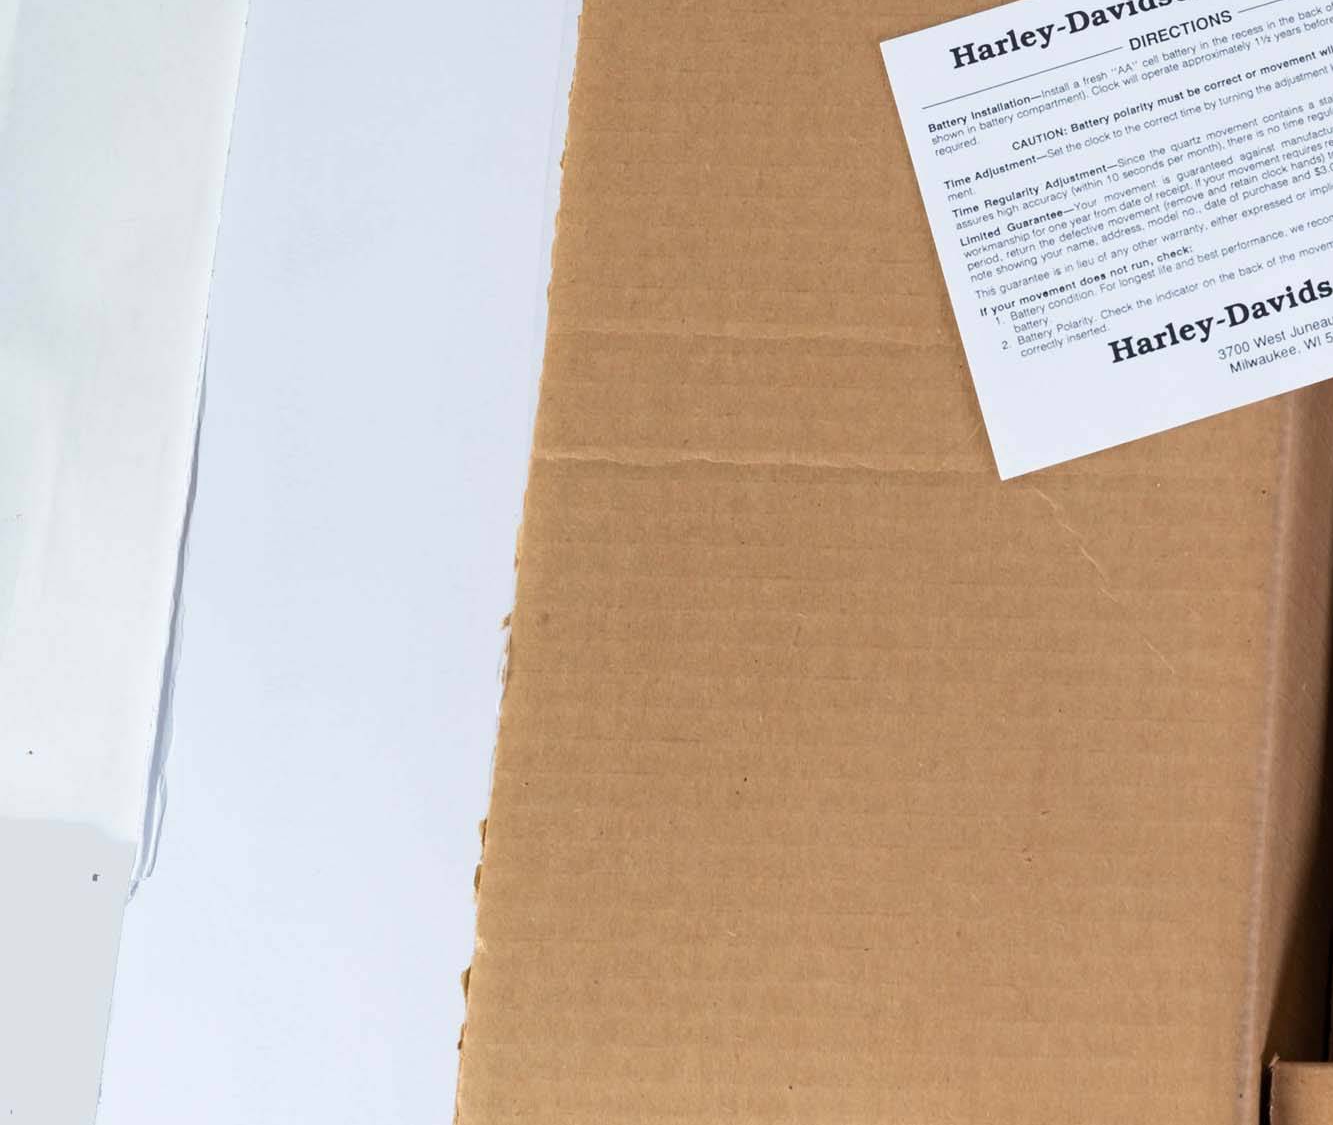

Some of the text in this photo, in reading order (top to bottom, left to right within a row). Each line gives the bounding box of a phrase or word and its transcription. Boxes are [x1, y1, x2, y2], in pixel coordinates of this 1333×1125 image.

[927, 115, 967, 133] Battery
[1073, 81, 1080, 89] a
[1082, 72, 1108, 85] fresh
[1142, 54, 1159, 67] cell
[1161, 45, 1196, 61] battery
[1199, 41, 1209, 49] in
[1211, 35, 1228, 46] the
[1231, 25, 1264, 40] recess
[1266, 21, 1276, 29] in
[1278, 15, 1295, 26] the
[1297, 6, 1323, 20] back
[1128, 9, 1232, 51] DIRECTIONS
[931, 129, 964, 145] shown
[966, 125, 976, 134] in
[978, 114, 1013, 130] battery
[1091, 80, 1120, 95] Clock
[1121, 73, 1138, 86] will
[1141, 63, 1179, 81] operate
[1182, 41, 1251, 68] approximately
[1273, 26, 1301, 42] years
[1011, 127, 1068, 150] CAUTION:
[1070, 115, 1109, 132] Battery
[1113, 101, 1153, 122] polarity
[1157, 91, 1184, 107] must
[1185, 87, 1200, 97] be
[1203, 73, 1242, 92] correct
[1245, 69, 1256, 79] or
[1259, 51, 1316, 75] movement
[951, 205, 979, 218] Time
[983, 186, 1039, 209] Regularity
[1149, 147, 1165, 157] the
[1170, 136, 1201, 152] quartz
[1206, 118, 1258, 140] movement
[1262, 105, 1304, 123] contains
[1308, 101, 1315, 109] a
[959, 226, 1000, 247] Limited
[1104, 180, 1156, 202] movement
[1162, 176, 1170, 184] is
[1176, 155, 1233, 182] guaranteed
[1239, 143, 1275, 161] against
[963, 232, 1030, 258] workmanship
[1032, 227, 1045, 237] for
[1048, 221, 1067, 232] one
[1069, 213, 1090, 228] year
[1093, 206, 1117, 218] from
[1119, 198, 1141, 211] date
[1143, 192, 1153, 203] of
[1194, 177, 1201, 187] If
[1202, 172, 1224, 187] your
[1227, 155, 1280, 177] movement
[1282, 143, 1323, 161] requires
[970, 270, 992, 282] note
[995, 256, 1037, 275] showing
[1040, 248, 1062, 263] your
[1066, 239, 1098, 252] name,
[1147, 210, 1179, 227] model
[1204, 197, 1226, 210] date
[1229, 191, 1239, 202] of
[1242, 179, 1288, 200] purchase
[1291, 170, 1311, 183] and
[979, 246, 1192, 316] If your movement does not run, check:
[1020, 338, 1063, 357] correctly
[1217, 341, 1250, 360] 3700
[1252, 330, 1286, 348] West
[1303, 335, 1321, 350] WI
